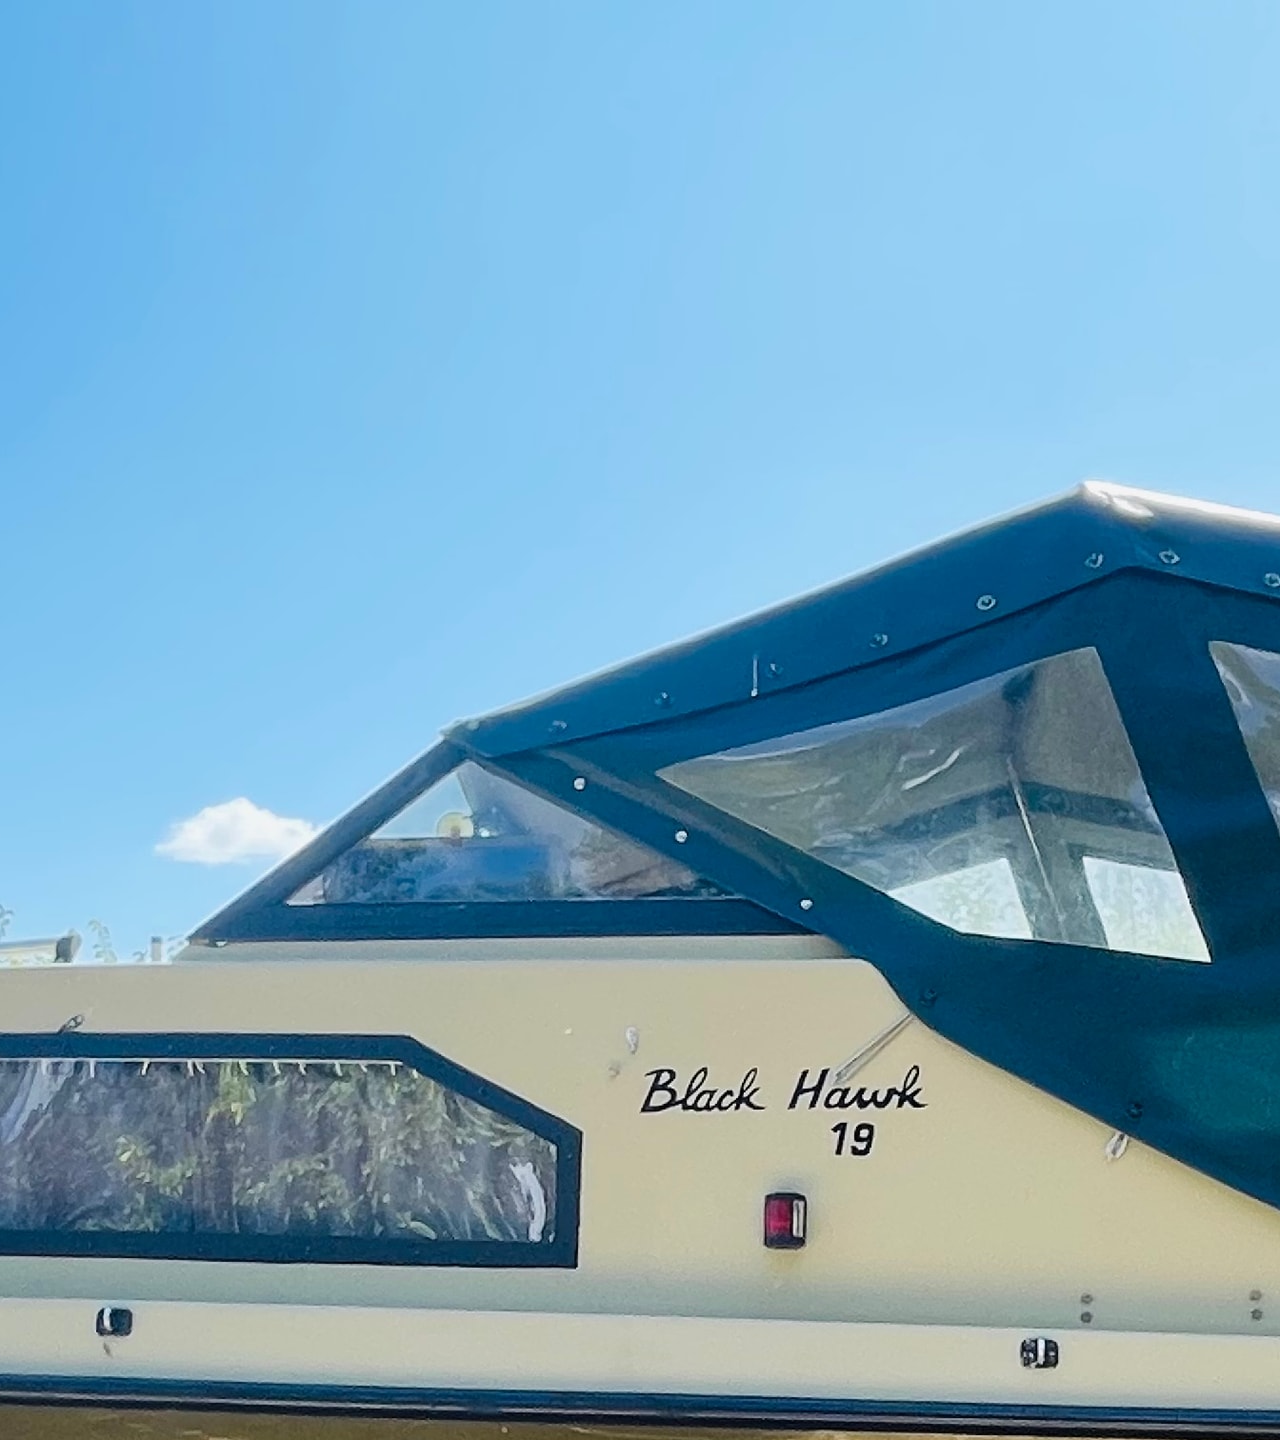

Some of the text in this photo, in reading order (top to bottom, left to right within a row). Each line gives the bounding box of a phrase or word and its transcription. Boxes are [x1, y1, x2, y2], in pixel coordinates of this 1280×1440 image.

[640, 1064, 929, 1113] Black Hawk
[831, 1121, 875, 1156] 19
